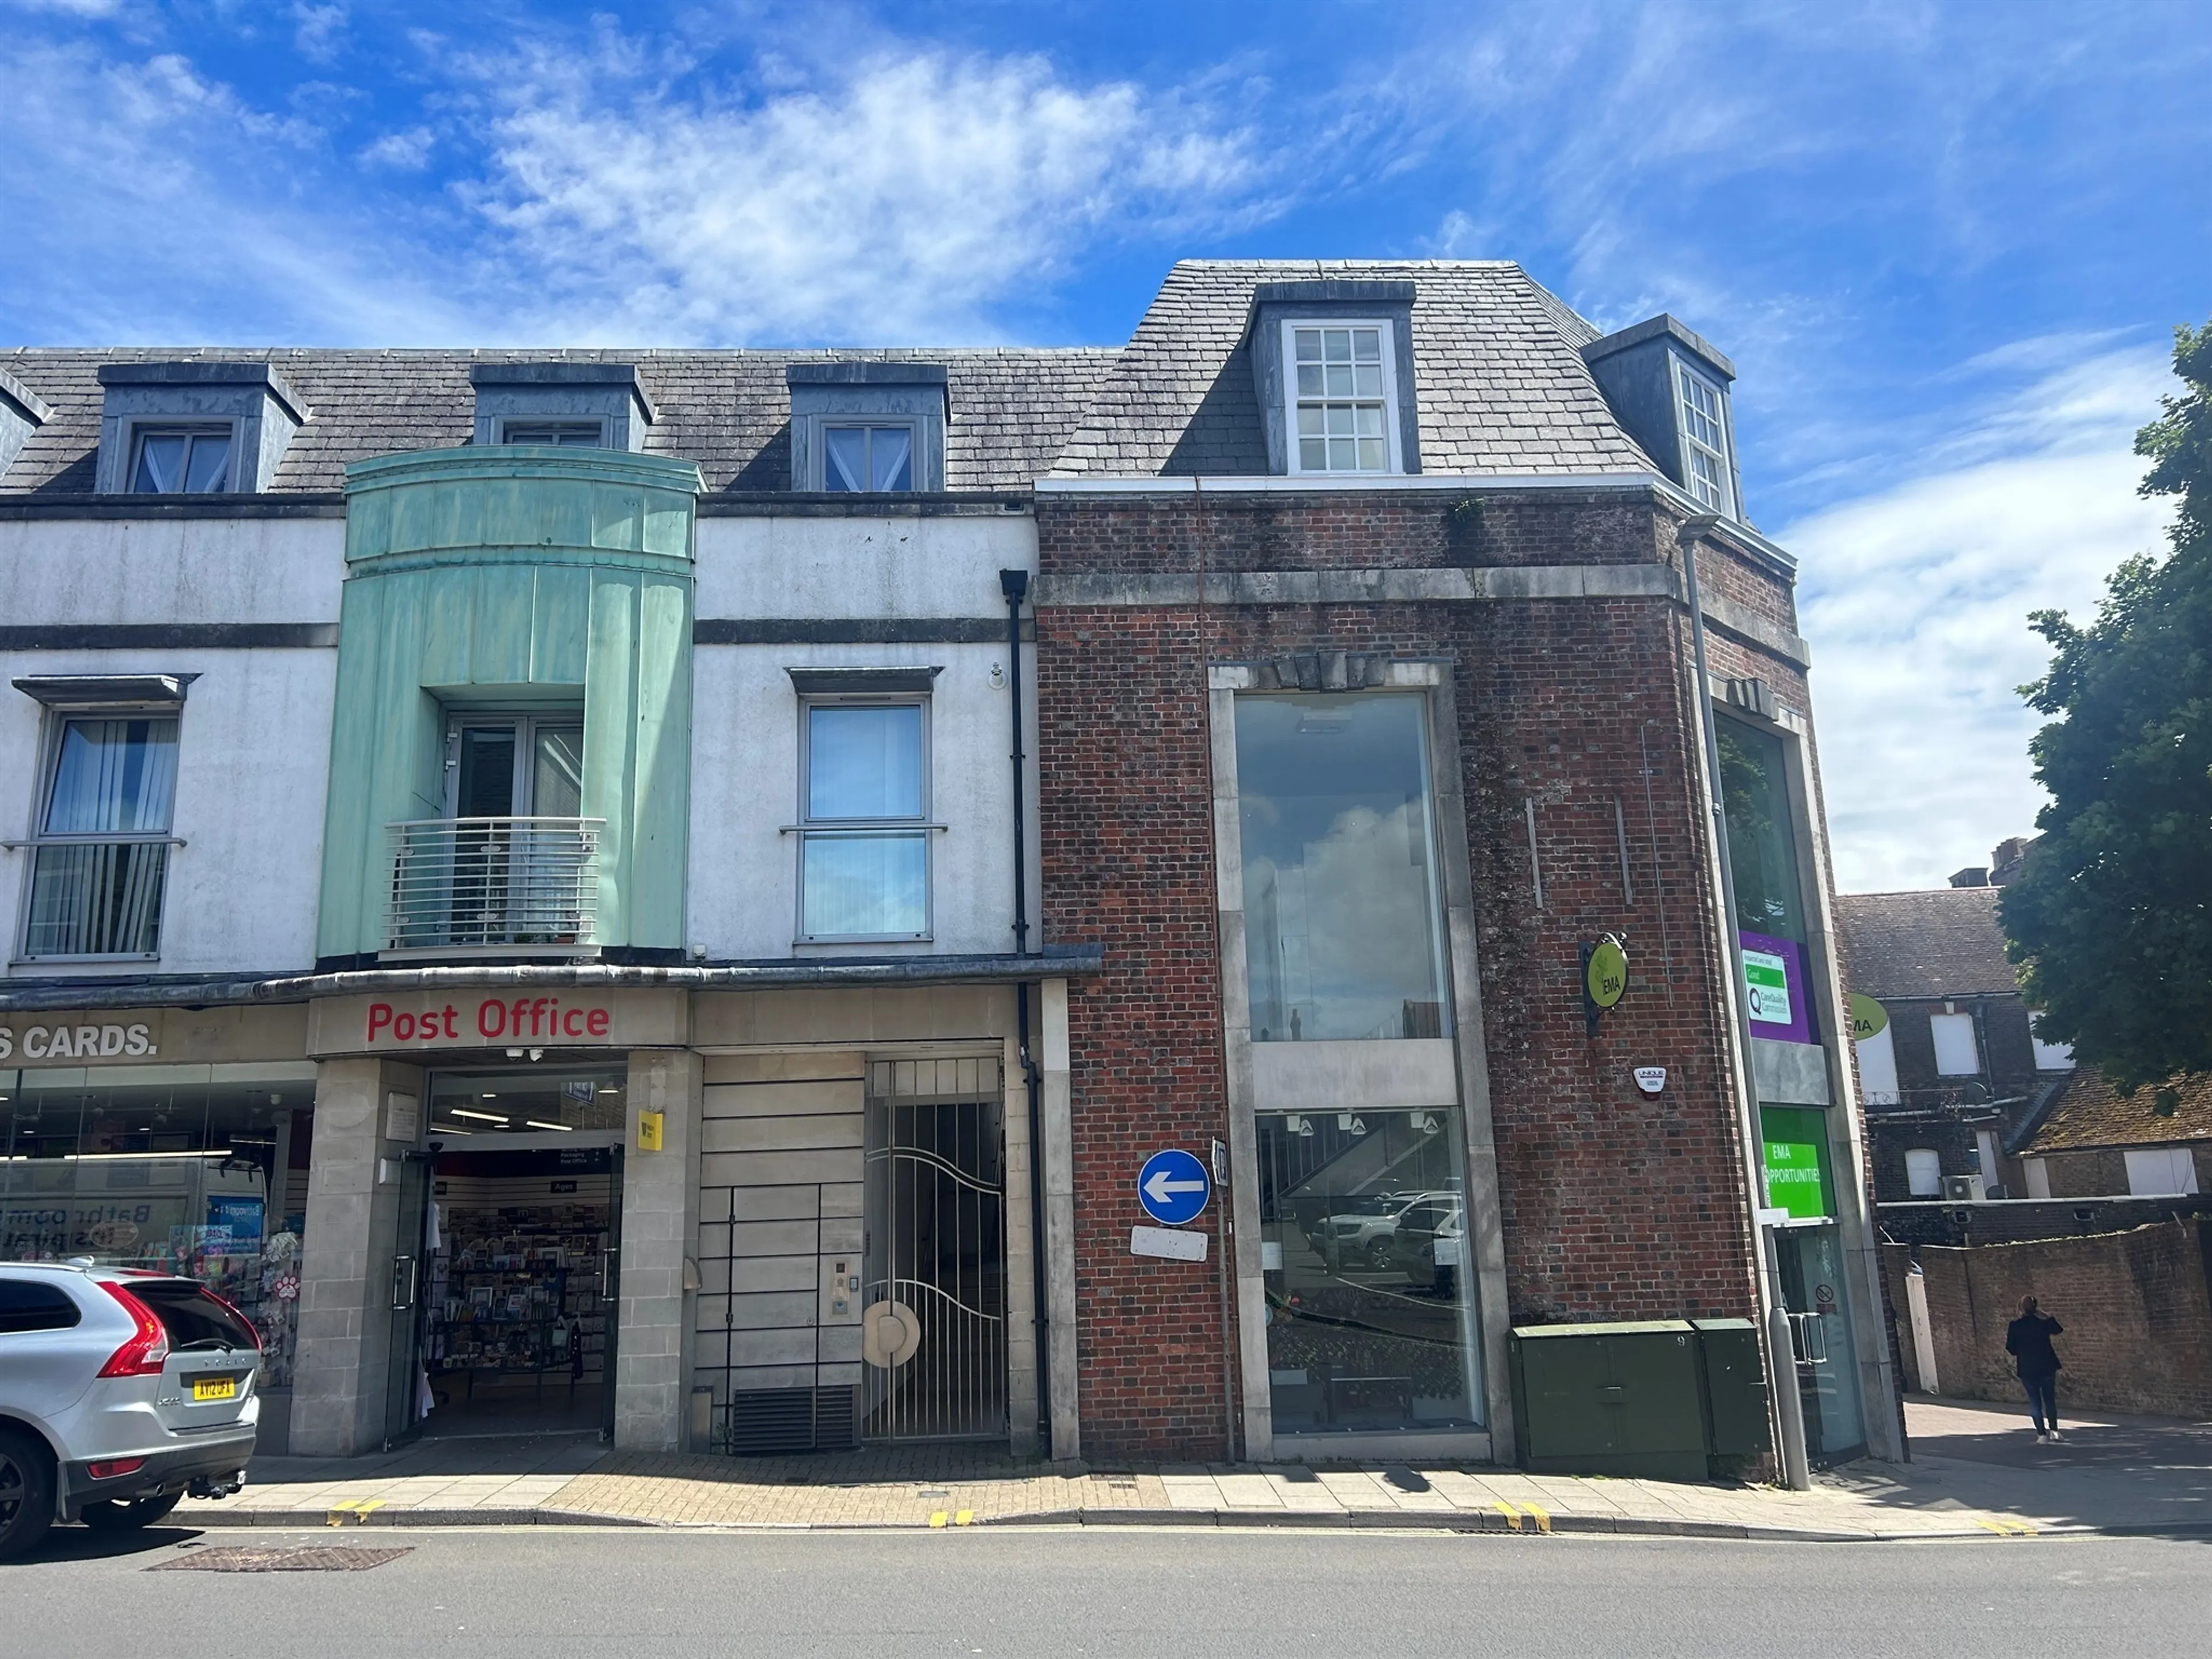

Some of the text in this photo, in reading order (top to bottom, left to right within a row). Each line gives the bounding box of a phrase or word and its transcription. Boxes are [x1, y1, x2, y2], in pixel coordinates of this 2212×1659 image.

[1747, 968, 1760, 979] Good
[1603, 975, 1620, 995] EMA
[368, 998, 609, 1042] Post Office
[1854, 1019, 1873, 1032] MA
[23, 1024, 157, 1058] CARDS.
[1772, 1145, 1791, 1159] EMA
[1677, 1336, 1684, 1346] 9
